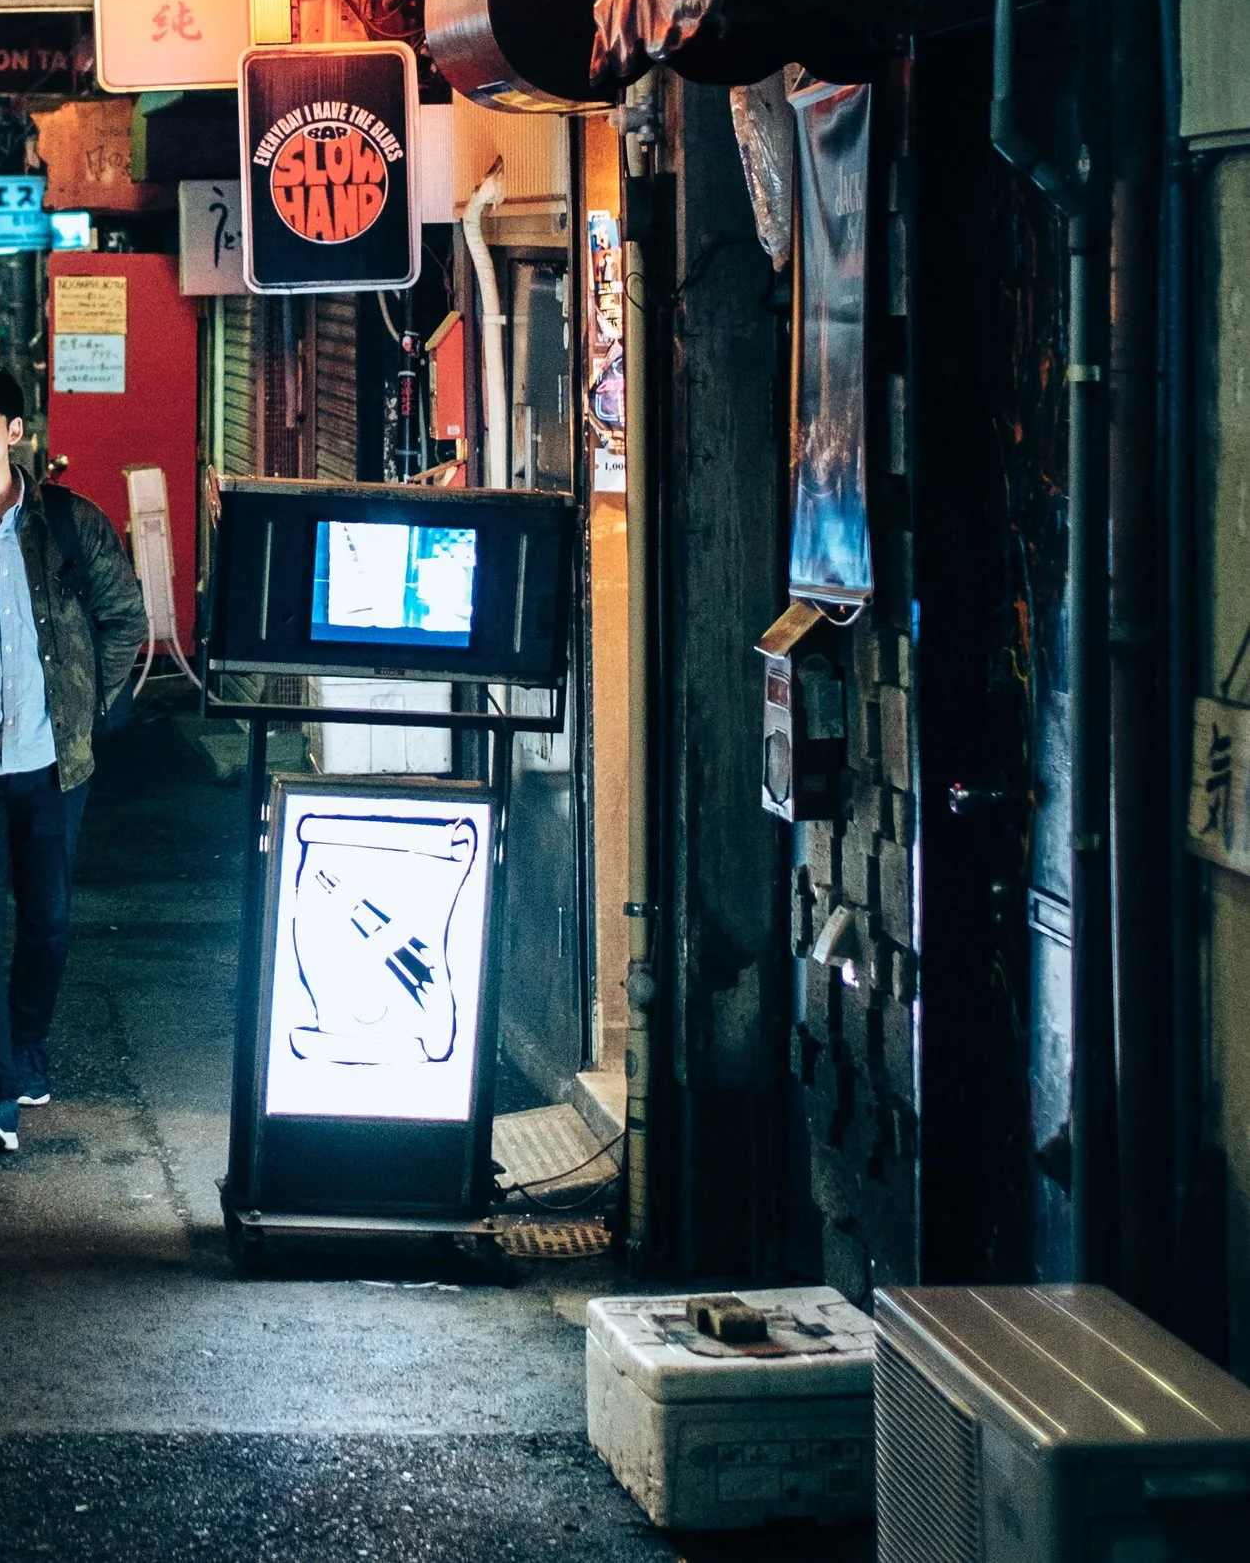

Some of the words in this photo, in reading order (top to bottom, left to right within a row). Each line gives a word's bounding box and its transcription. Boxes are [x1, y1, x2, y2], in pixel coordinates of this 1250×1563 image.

[152, 1, 203, 42] 純
[252, 108, 305, 167] EVERYDAY
[312, 101, 349, 121] HAVE
[348, 104, 377, 131] THE
[367, 120, 404, 163] BLUES
[306, 125, 349, 140] BAR
[272, 128, 386, 187] SLOW
[273, 184, 385, 241] HAND
[604, 463, 625, 471] 1,00
